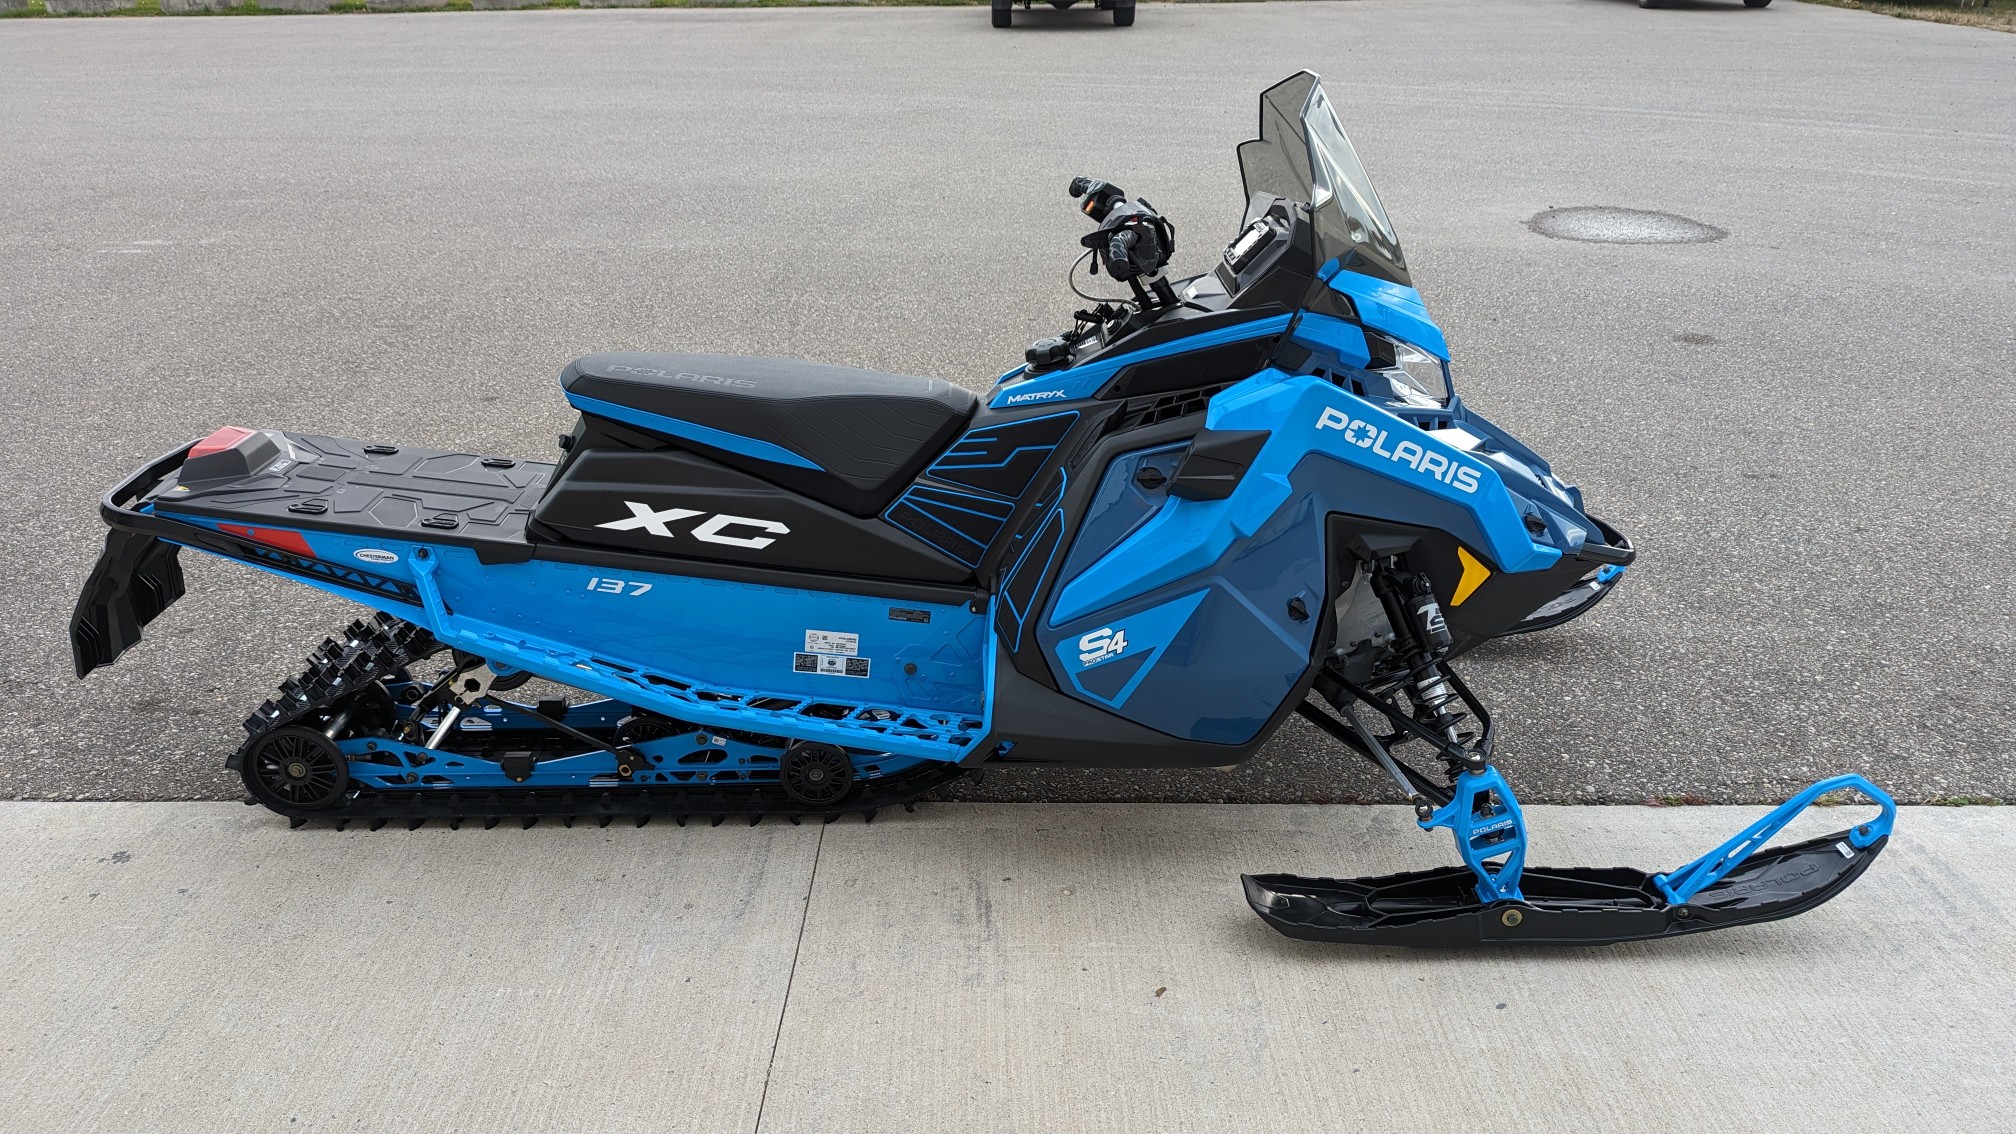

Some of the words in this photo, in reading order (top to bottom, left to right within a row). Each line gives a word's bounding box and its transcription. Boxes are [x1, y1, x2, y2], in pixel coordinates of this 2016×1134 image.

[606, 364, 757, 389] POLARIS
[1007, 389, 1067, 405] MATRYX
[1315, 406, 1482, 494] POLARIS
[594, 500, 791, 549] XC
[586, 577, 653, 596] 137
[1079, 627, 1128, 661] S4
[1472, 819, 1513, 835] POLARIS
[1708, 862, 1820, 901] POLARIS
